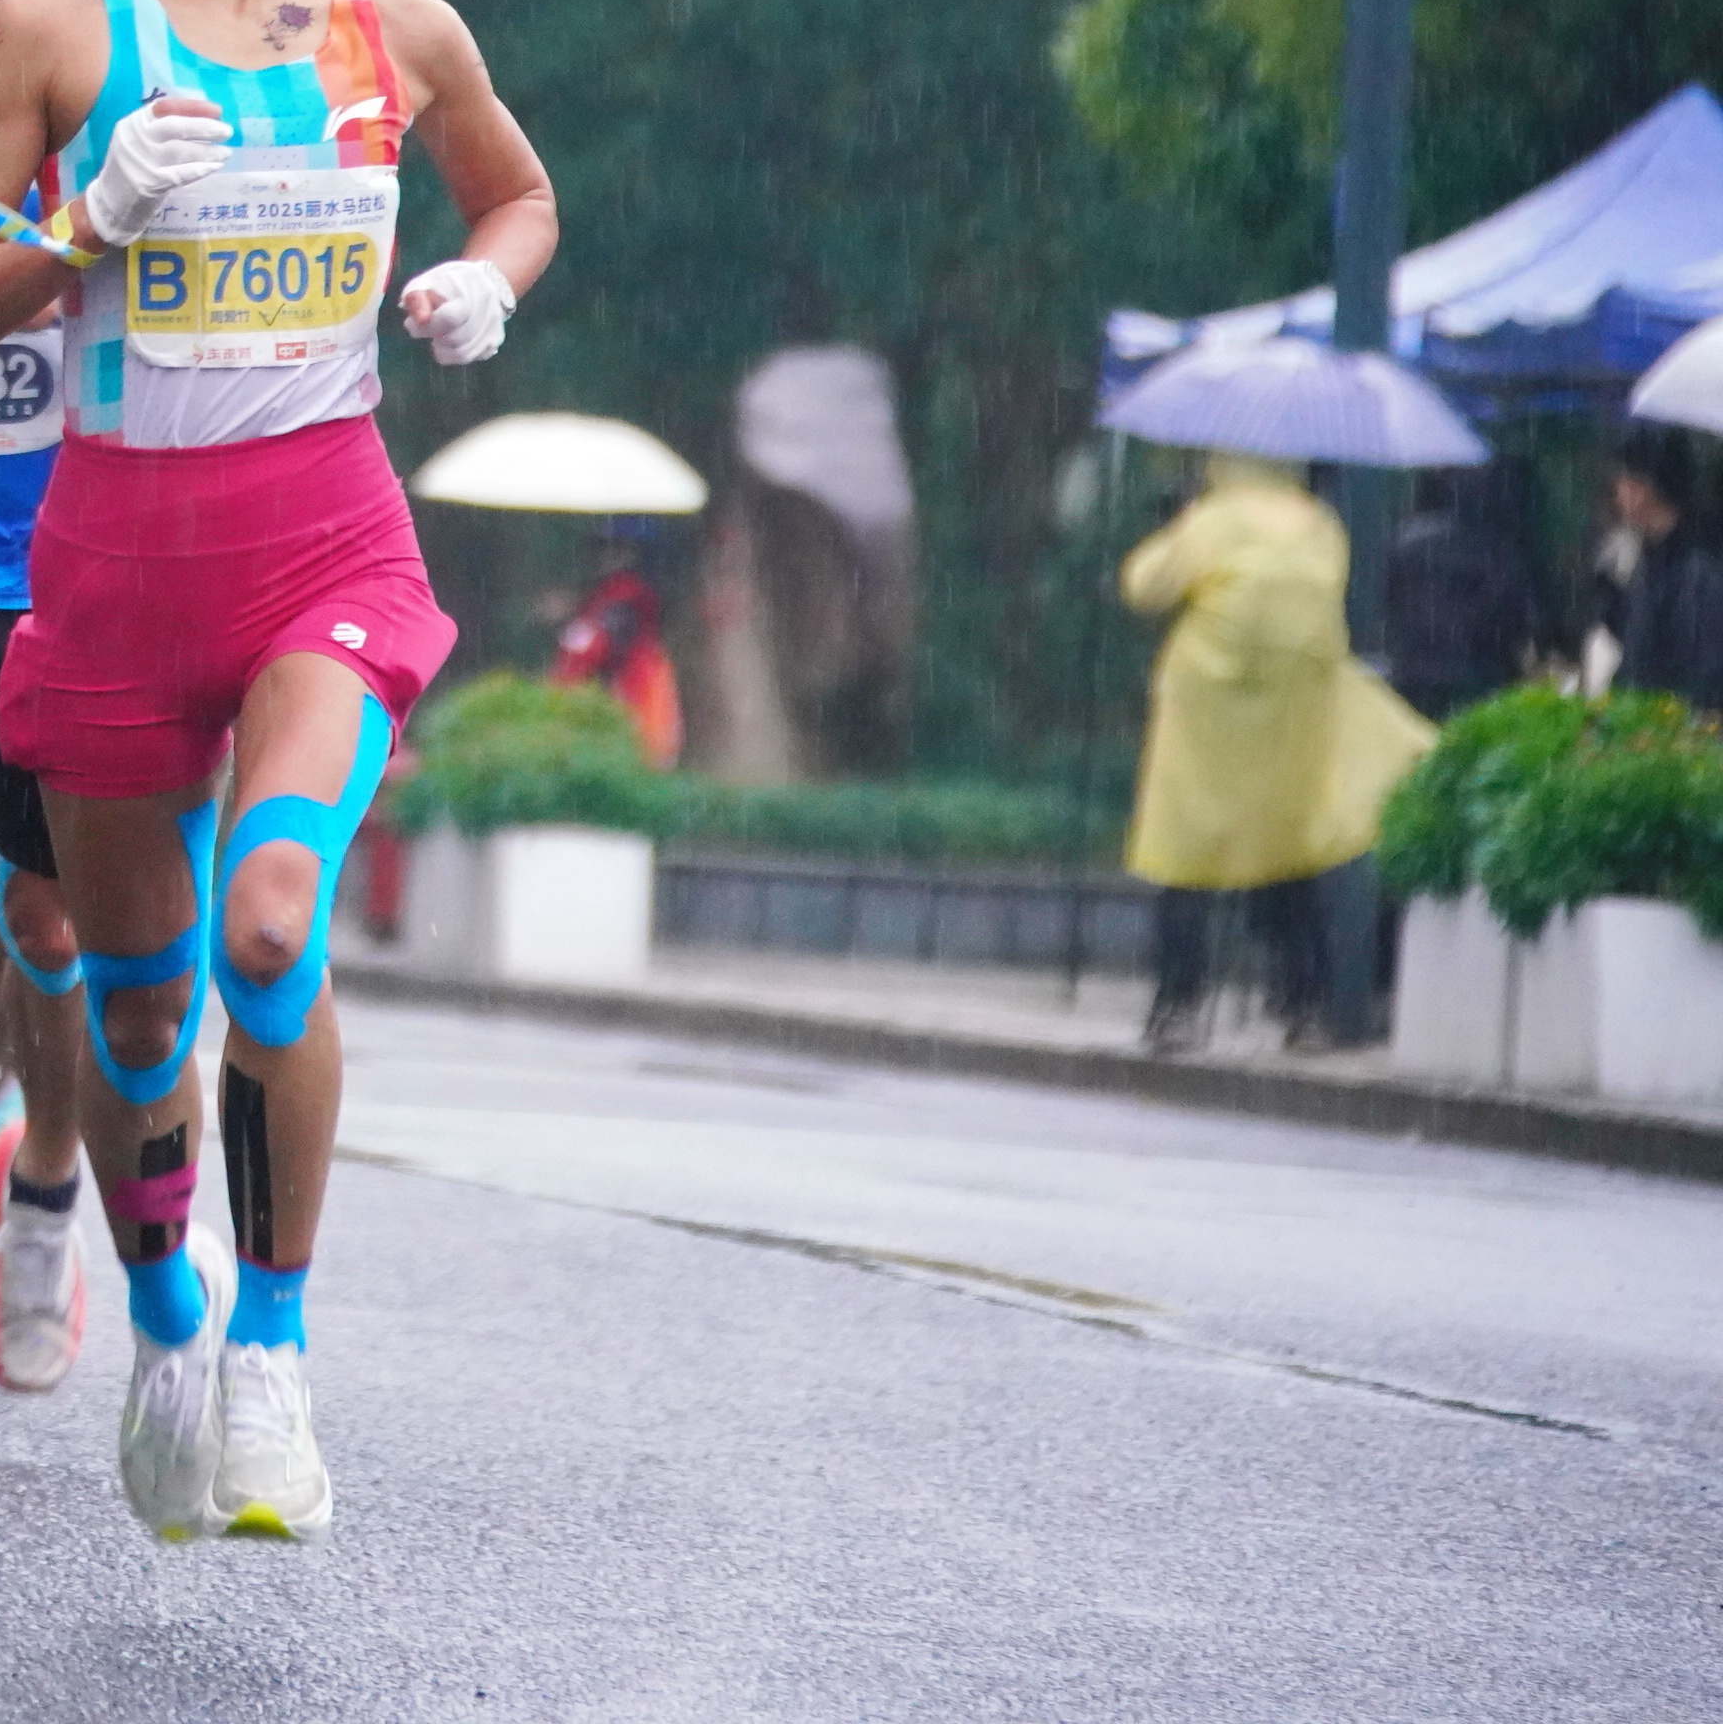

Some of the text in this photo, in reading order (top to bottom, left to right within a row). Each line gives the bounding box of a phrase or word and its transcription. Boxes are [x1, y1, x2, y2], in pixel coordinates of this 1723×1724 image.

[257, 193, 387, 218] 2025丽水马拉松
[139, 242, 368, 311] B 76015
